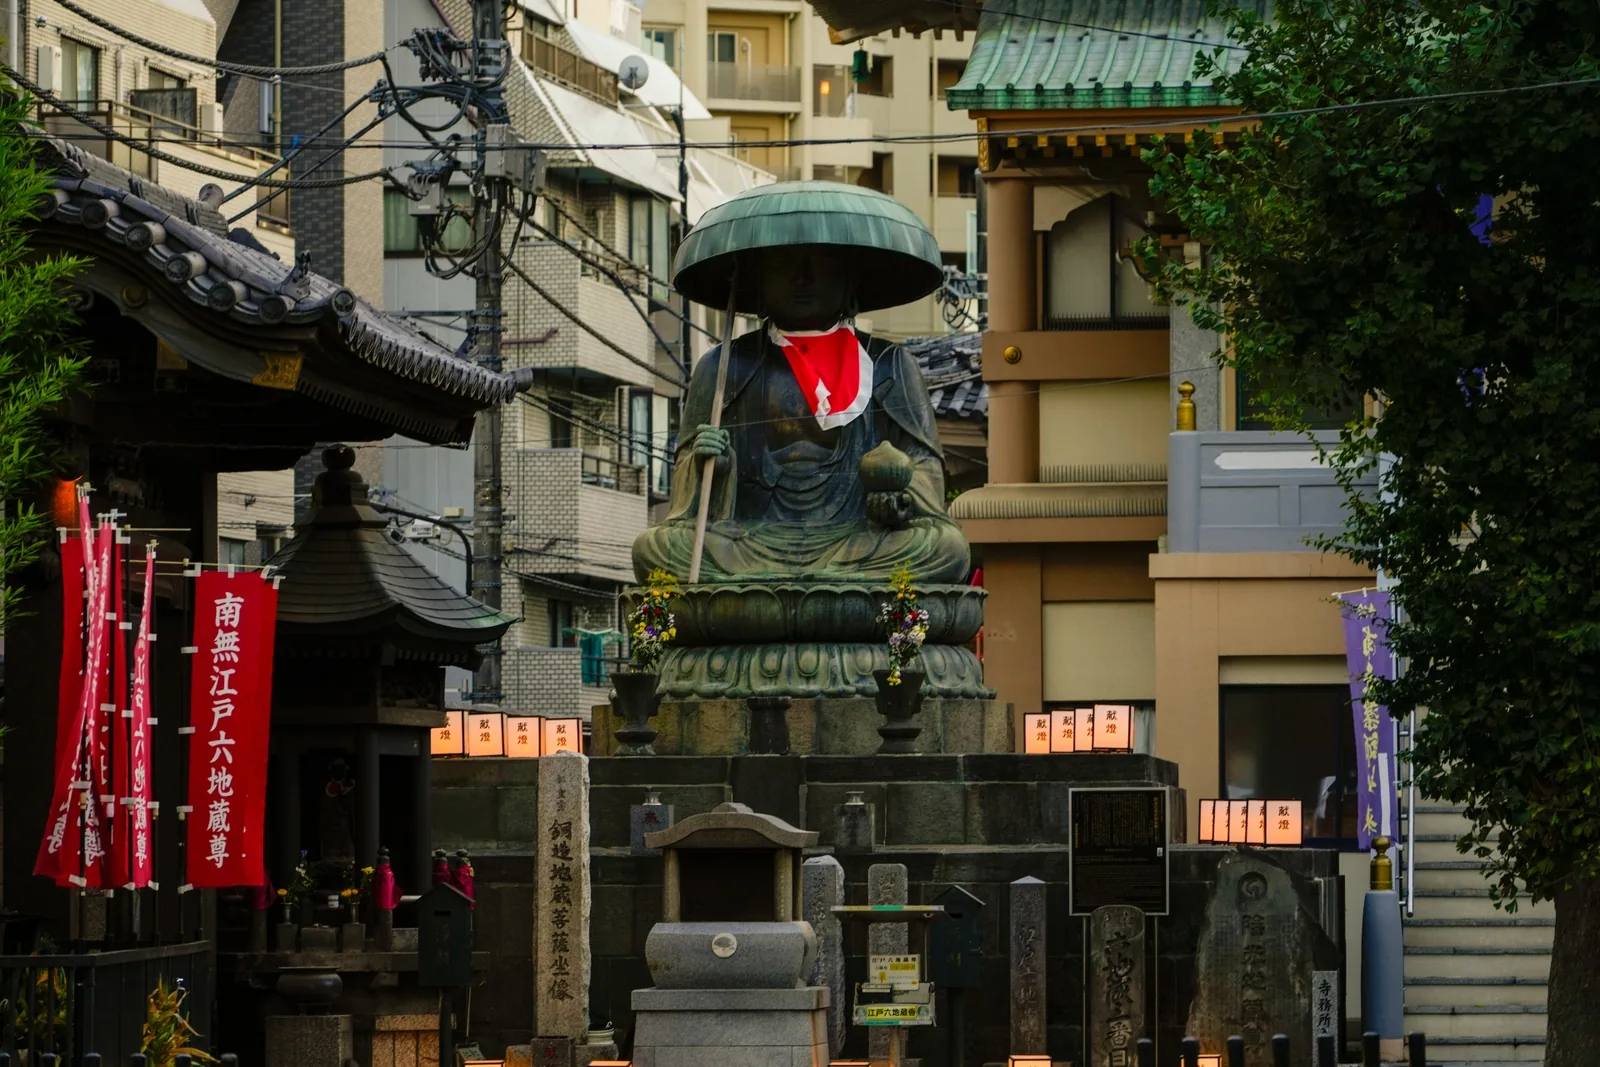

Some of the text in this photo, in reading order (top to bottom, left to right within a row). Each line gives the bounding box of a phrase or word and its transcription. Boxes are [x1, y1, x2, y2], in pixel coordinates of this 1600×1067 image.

[205, 592, 245, 868] 南無江戸六地蔵尊
[440, 717, 451, 740] 燈
